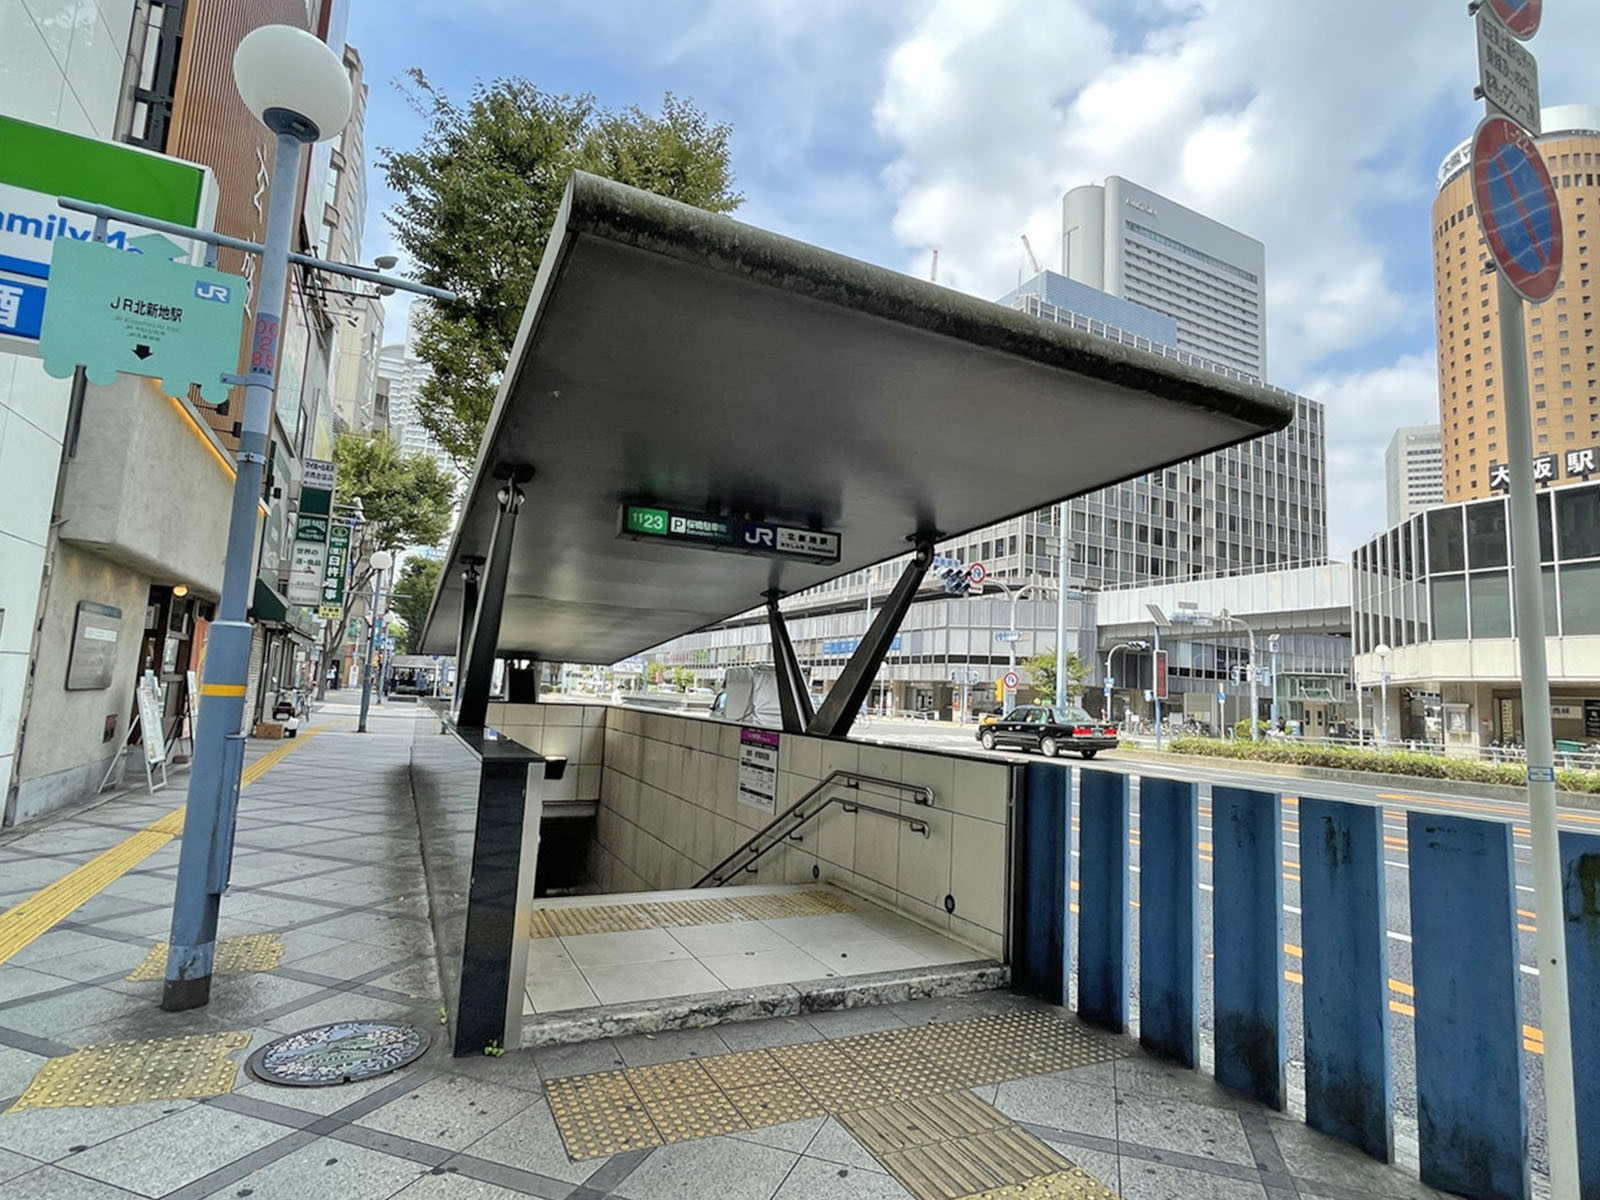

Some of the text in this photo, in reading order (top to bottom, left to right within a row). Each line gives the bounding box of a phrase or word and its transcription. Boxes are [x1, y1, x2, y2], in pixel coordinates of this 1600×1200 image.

[197, 284, 229, 301] JR
[110, 296, 183, 322] JR北新地駅
[744, 527, 773, 546] JR
